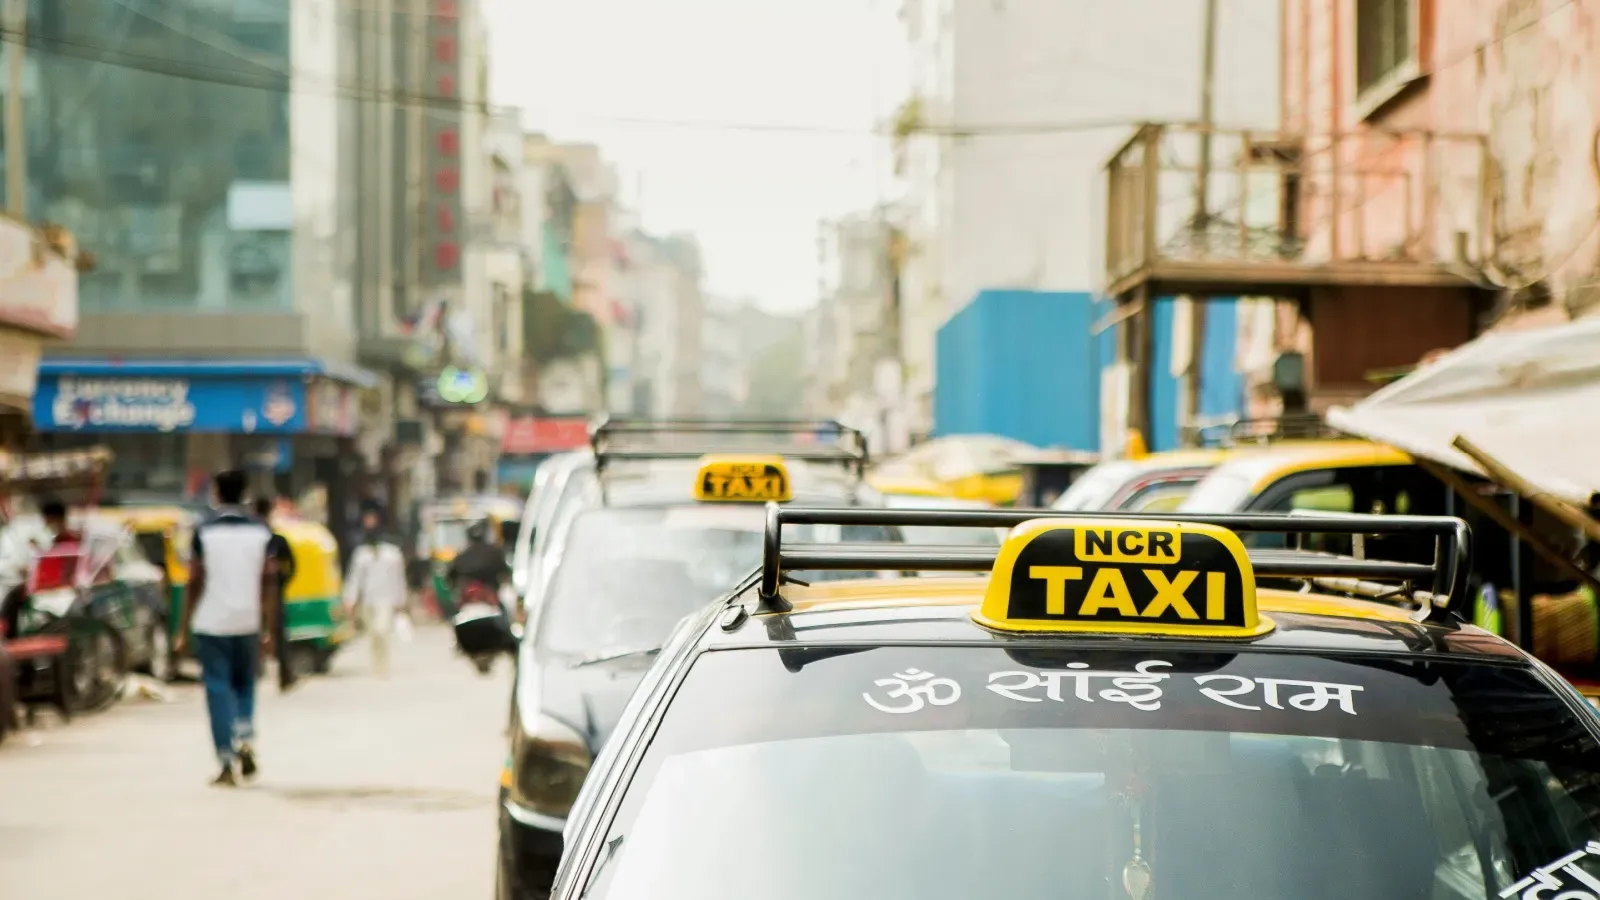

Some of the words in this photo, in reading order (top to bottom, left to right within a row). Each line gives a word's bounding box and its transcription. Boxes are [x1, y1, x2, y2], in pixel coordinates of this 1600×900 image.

[709, 475, 780, 497] TAXI
[1085, 530, 1175, 557] NCR
[1029, 565, 1226, 620] TAXI
[985, 660, 1173, 711] सांई
[1193, 674, 1364, 715] राम
